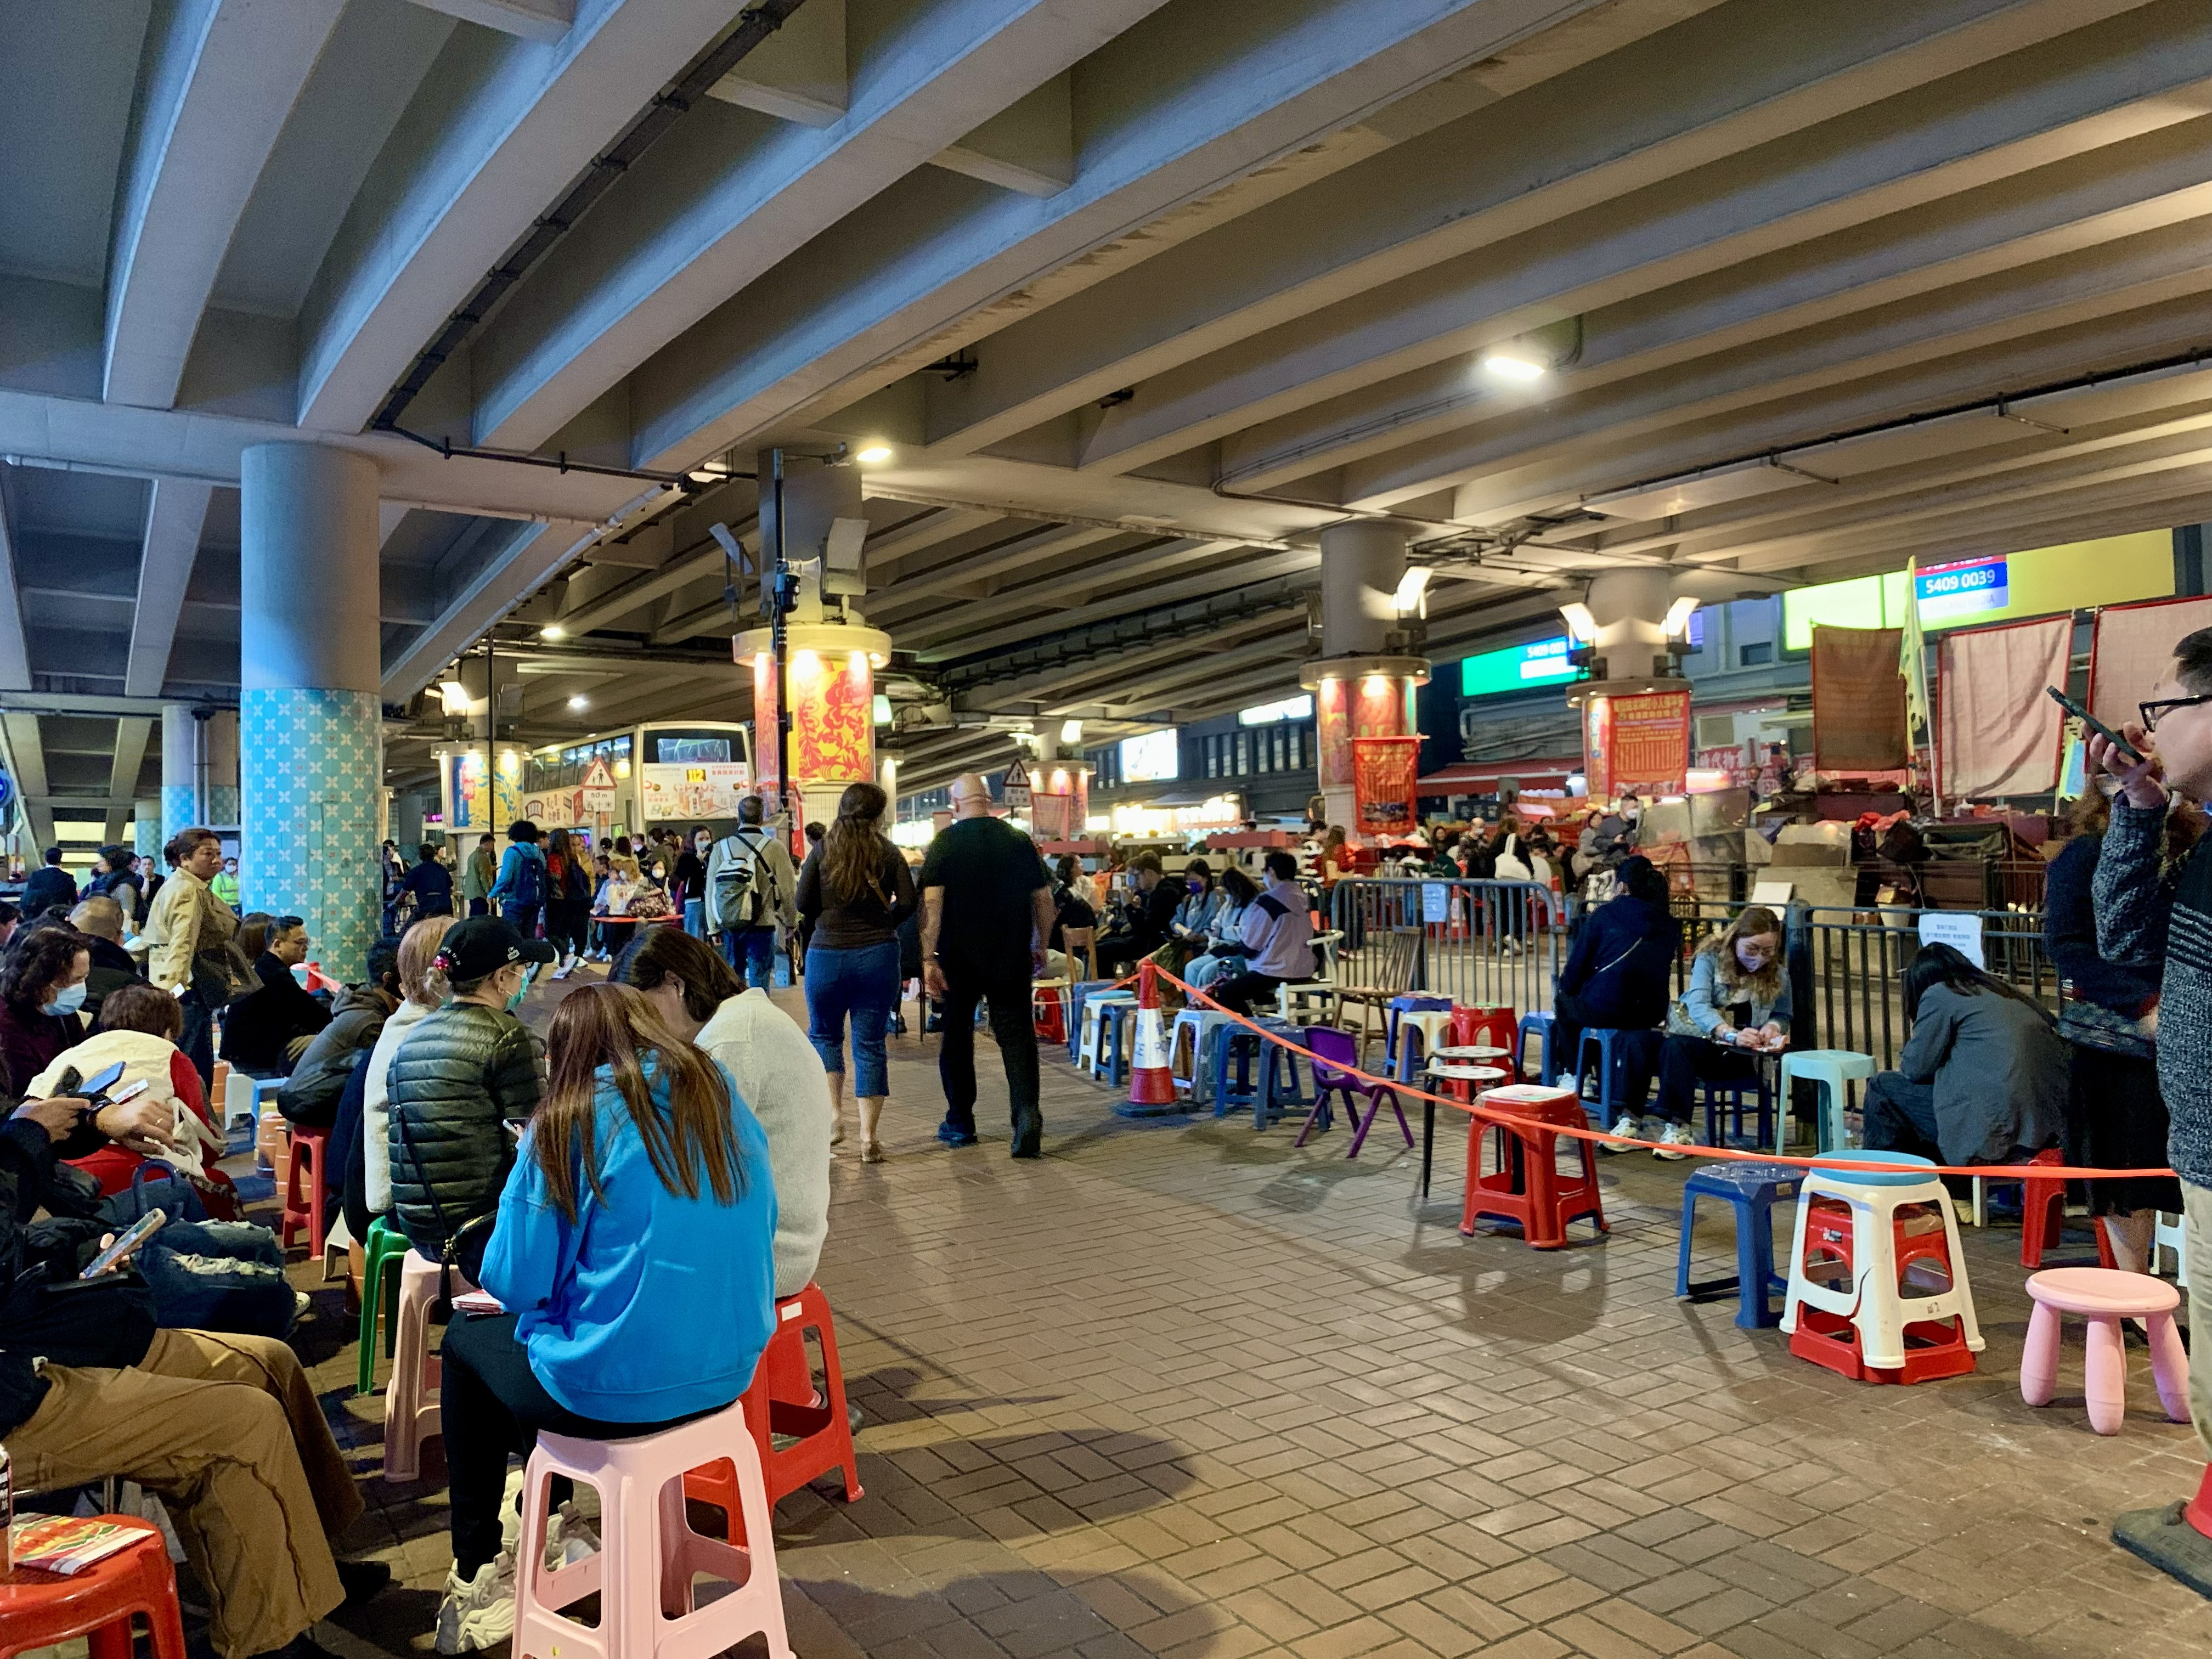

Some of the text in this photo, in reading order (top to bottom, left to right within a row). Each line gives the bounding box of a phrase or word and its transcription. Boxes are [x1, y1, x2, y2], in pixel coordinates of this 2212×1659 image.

[1926, 569, 1995, 594] 5409 0039
[1527, 641, 1566, 658] 5409 003
[687, 769, 704, 783] 112
